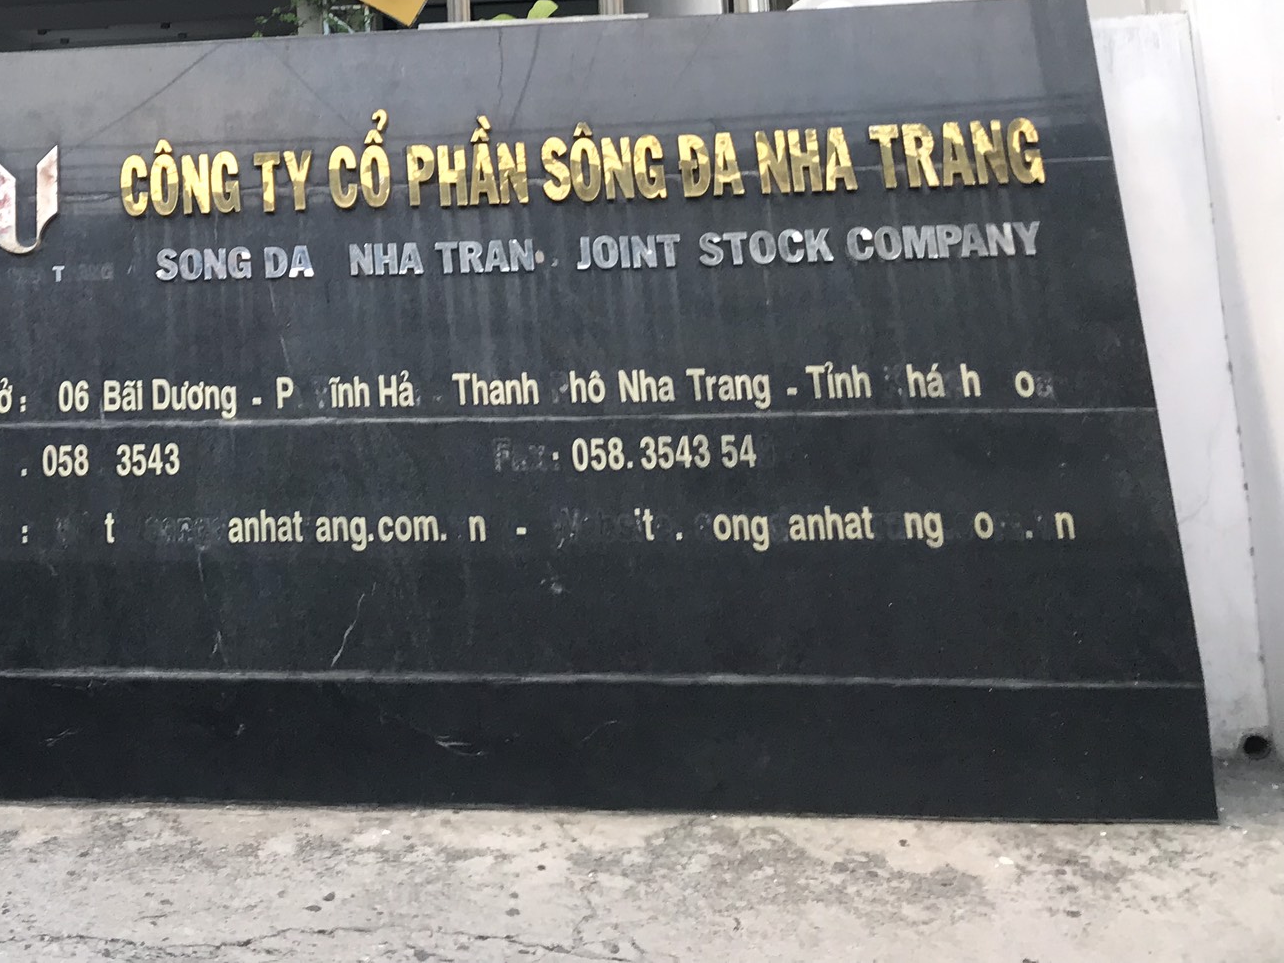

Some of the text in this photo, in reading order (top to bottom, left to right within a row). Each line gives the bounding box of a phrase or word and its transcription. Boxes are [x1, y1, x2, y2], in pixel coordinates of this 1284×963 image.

[119, 139, 241, 217] CÔNG
[253, 149, 313, 213] TY
[328, 108, 392, 210] CỔ
[406, 114, 530, 207] PHẦN
[541, 121, 668, 203] SÔNG
[755, 126, 859, 195] NHA
[868, 117, 1047, 190] TRANG
[156, 244, 252, 282] SONG
[264, 244, 314, 279] DA
[349, 240, 424, 277] NHA
[434, 239, 536, 275] TRAN
[577, 233, 681, 272] JOINT
[698, 228, 835, 267] STOCK
[846, 220, 1041, 263] COMPANY
[58, 380, 90, 413] 06
[103, 378, 143, 412] Bãi
[152, 376, 237, 420] Dương
[619, 369, 674, 404] Nha
[686, 367, 771, 410] Trang
[805, 360, 872, 399] Tỉnh
[42, 444, 90, 478] 058
[116, 442, 182, 477] 3543
